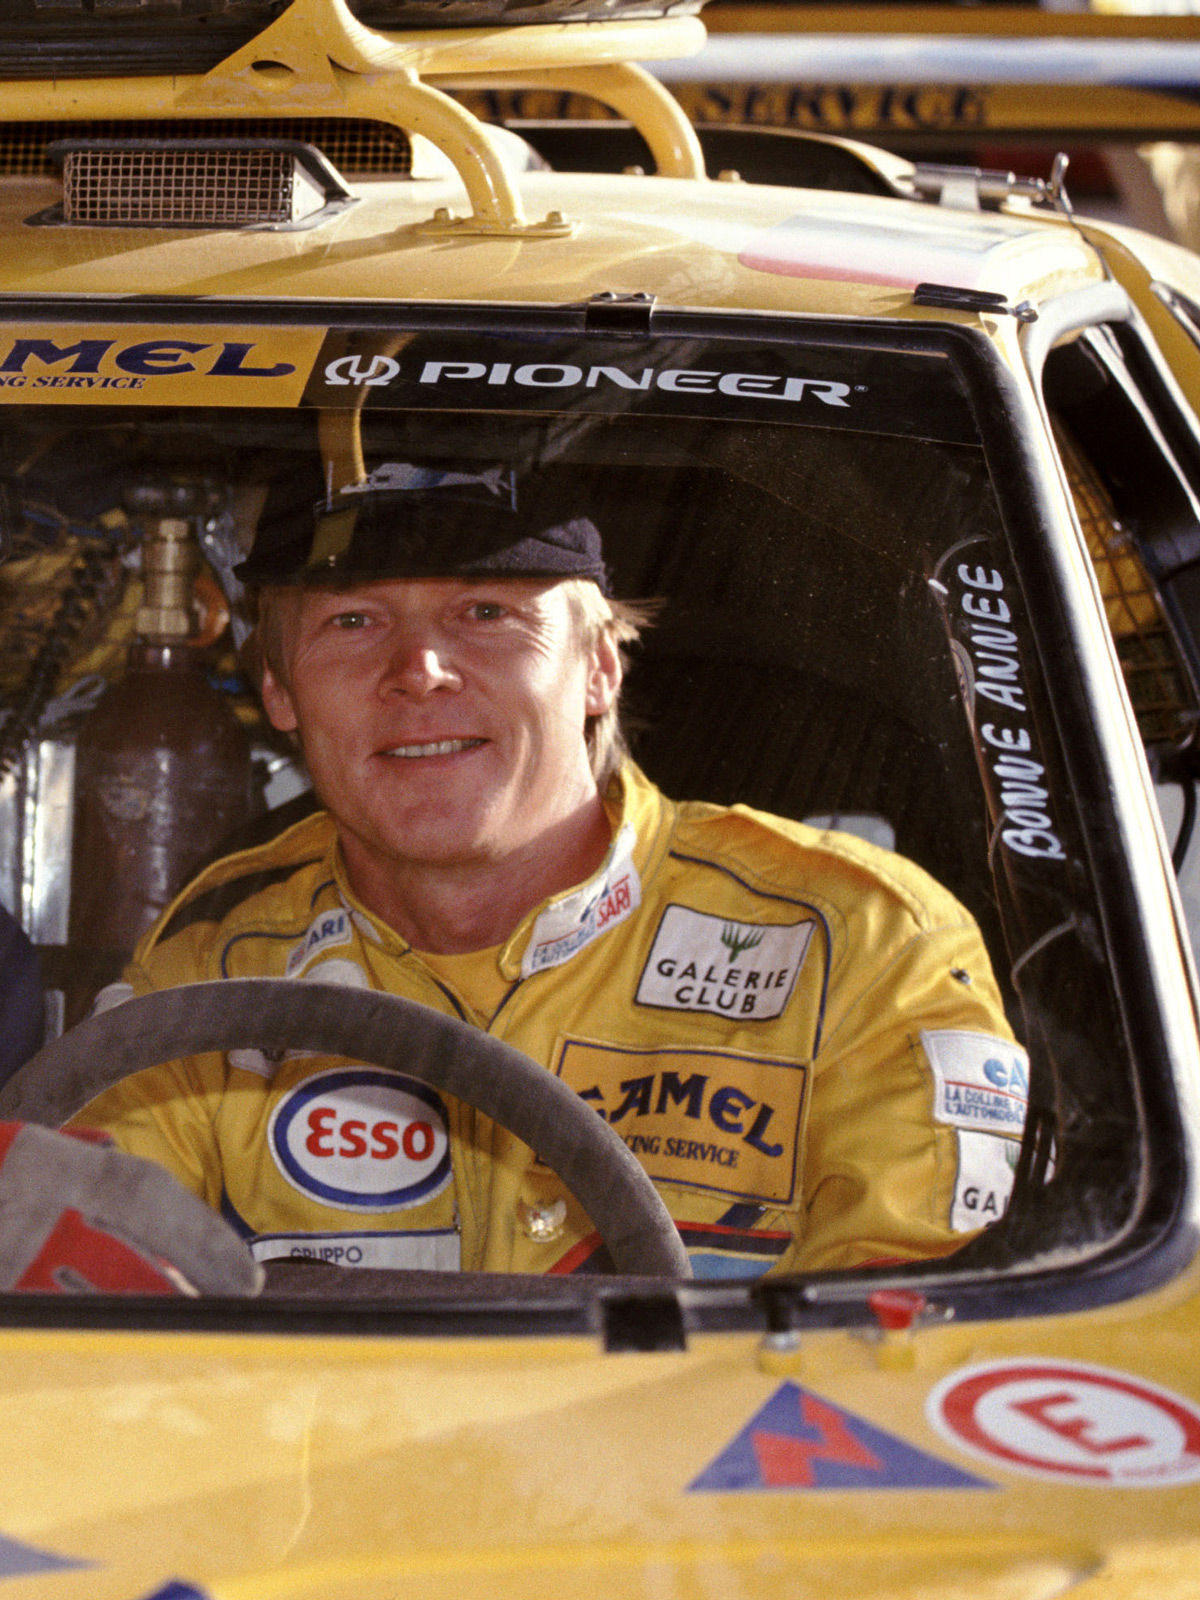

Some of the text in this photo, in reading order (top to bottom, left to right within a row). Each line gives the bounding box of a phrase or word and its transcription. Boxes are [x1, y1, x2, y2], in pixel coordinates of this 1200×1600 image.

[698, 82, 986, 130] SERVICE
[31, 375, 147, 391] SERVICE
[419, 360, 852, 408] PIONEER
[981, 723, 1068, 860] BONNE
[657, 949, 790, 990] GALERIE
[674, 986, 758, 1014] CLUB
[663, 1137, 740, 1168] SERVICE
